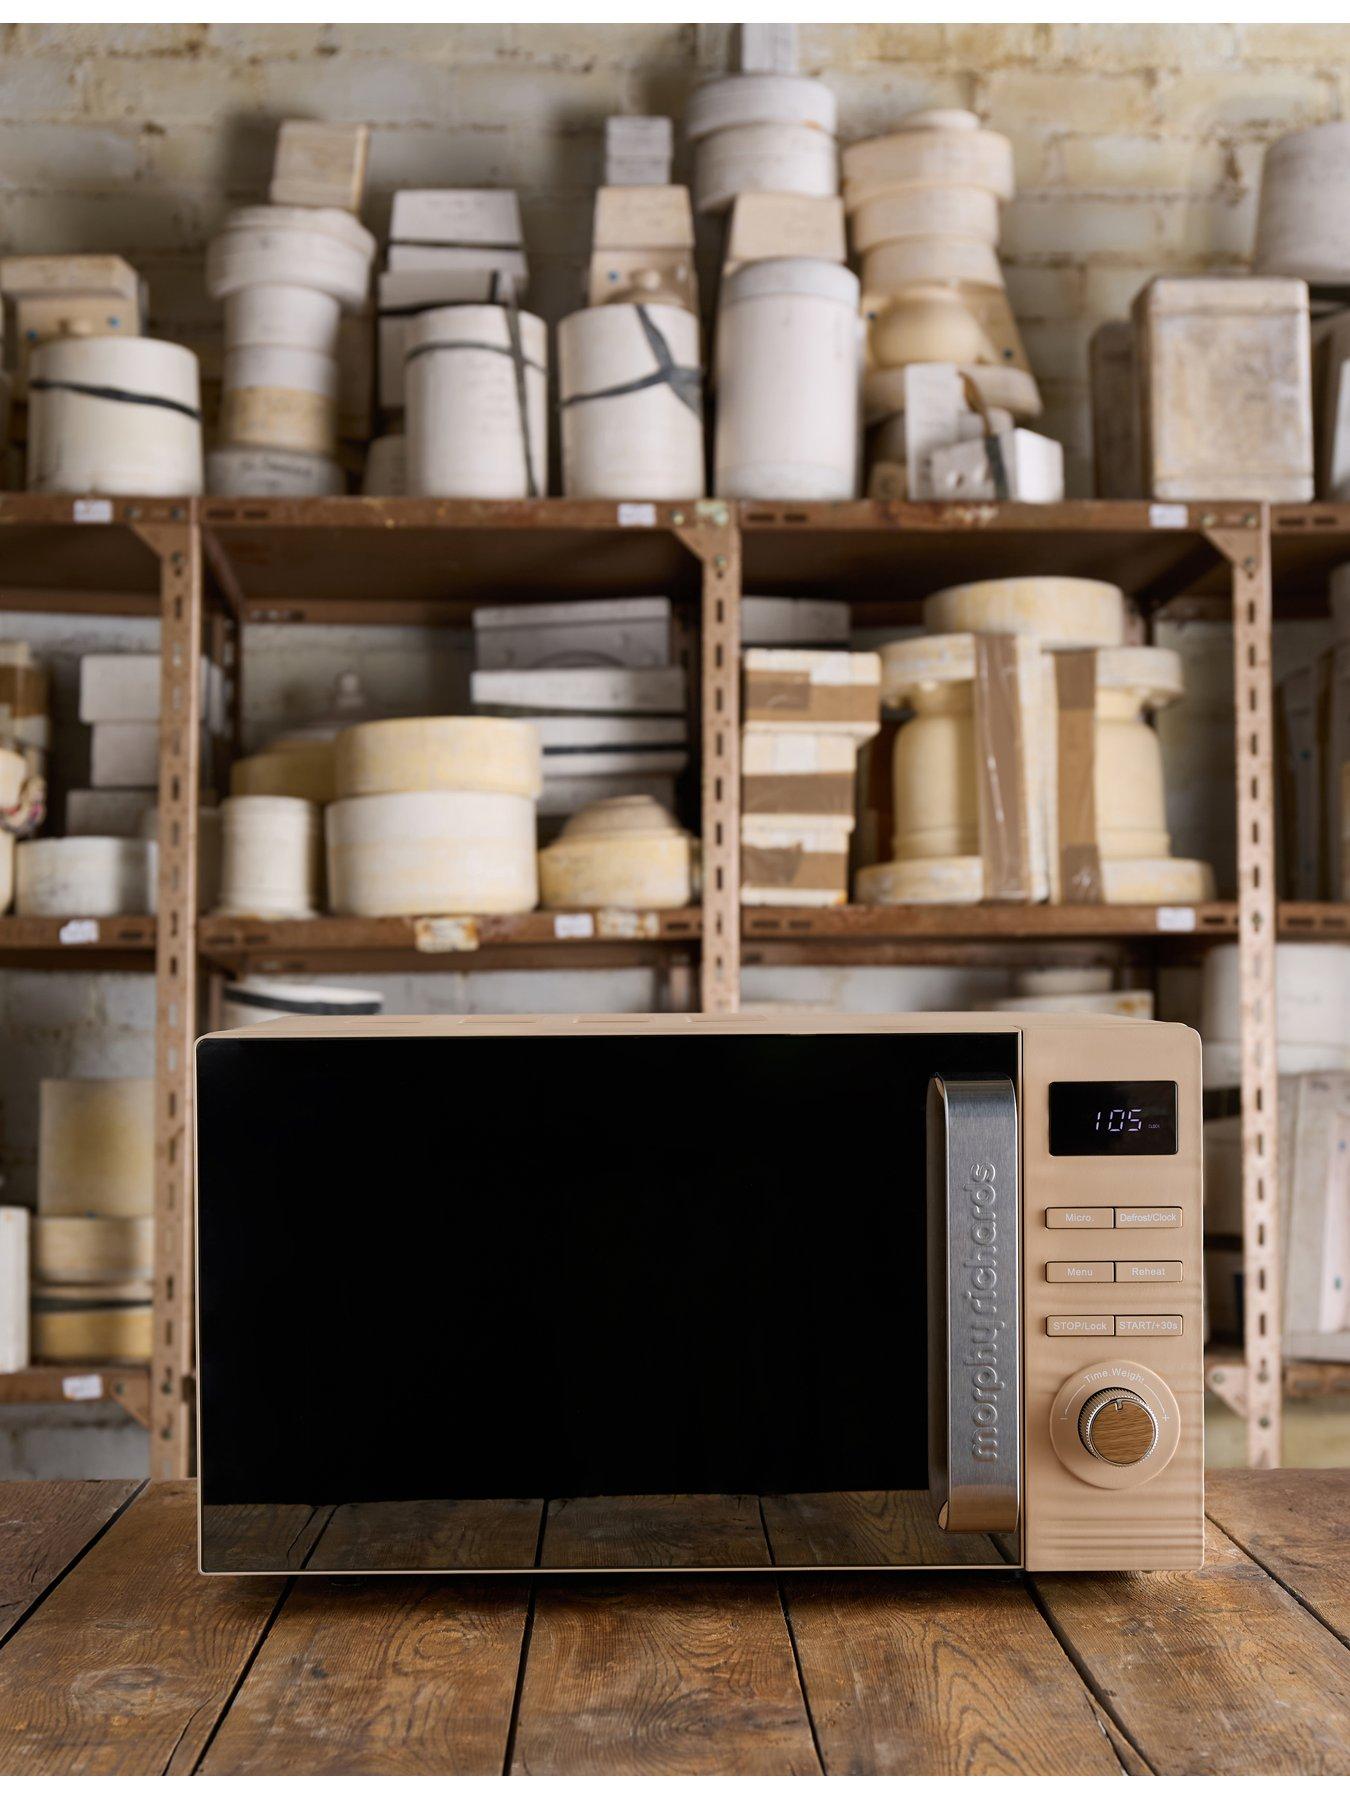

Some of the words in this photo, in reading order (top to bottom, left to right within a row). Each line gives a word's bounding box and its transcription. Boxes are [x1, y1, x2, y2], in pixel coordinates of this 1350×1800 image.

[1096, 1109, 1142, 1132] 105
[1119, 1212, 1177, 1222] Defrost/Clock
[963, 1161, 997, 1315] richards
[1067, 1267, 1093, 1276] Menu
[1131, 1267, 1166, 1276] Reheat
[1053, 1321, 1107, 1331] STOP/Lock
[1119, 1320, 1178, 1330] START/+30s
[963, 1319, 1005, 1463] morphy
